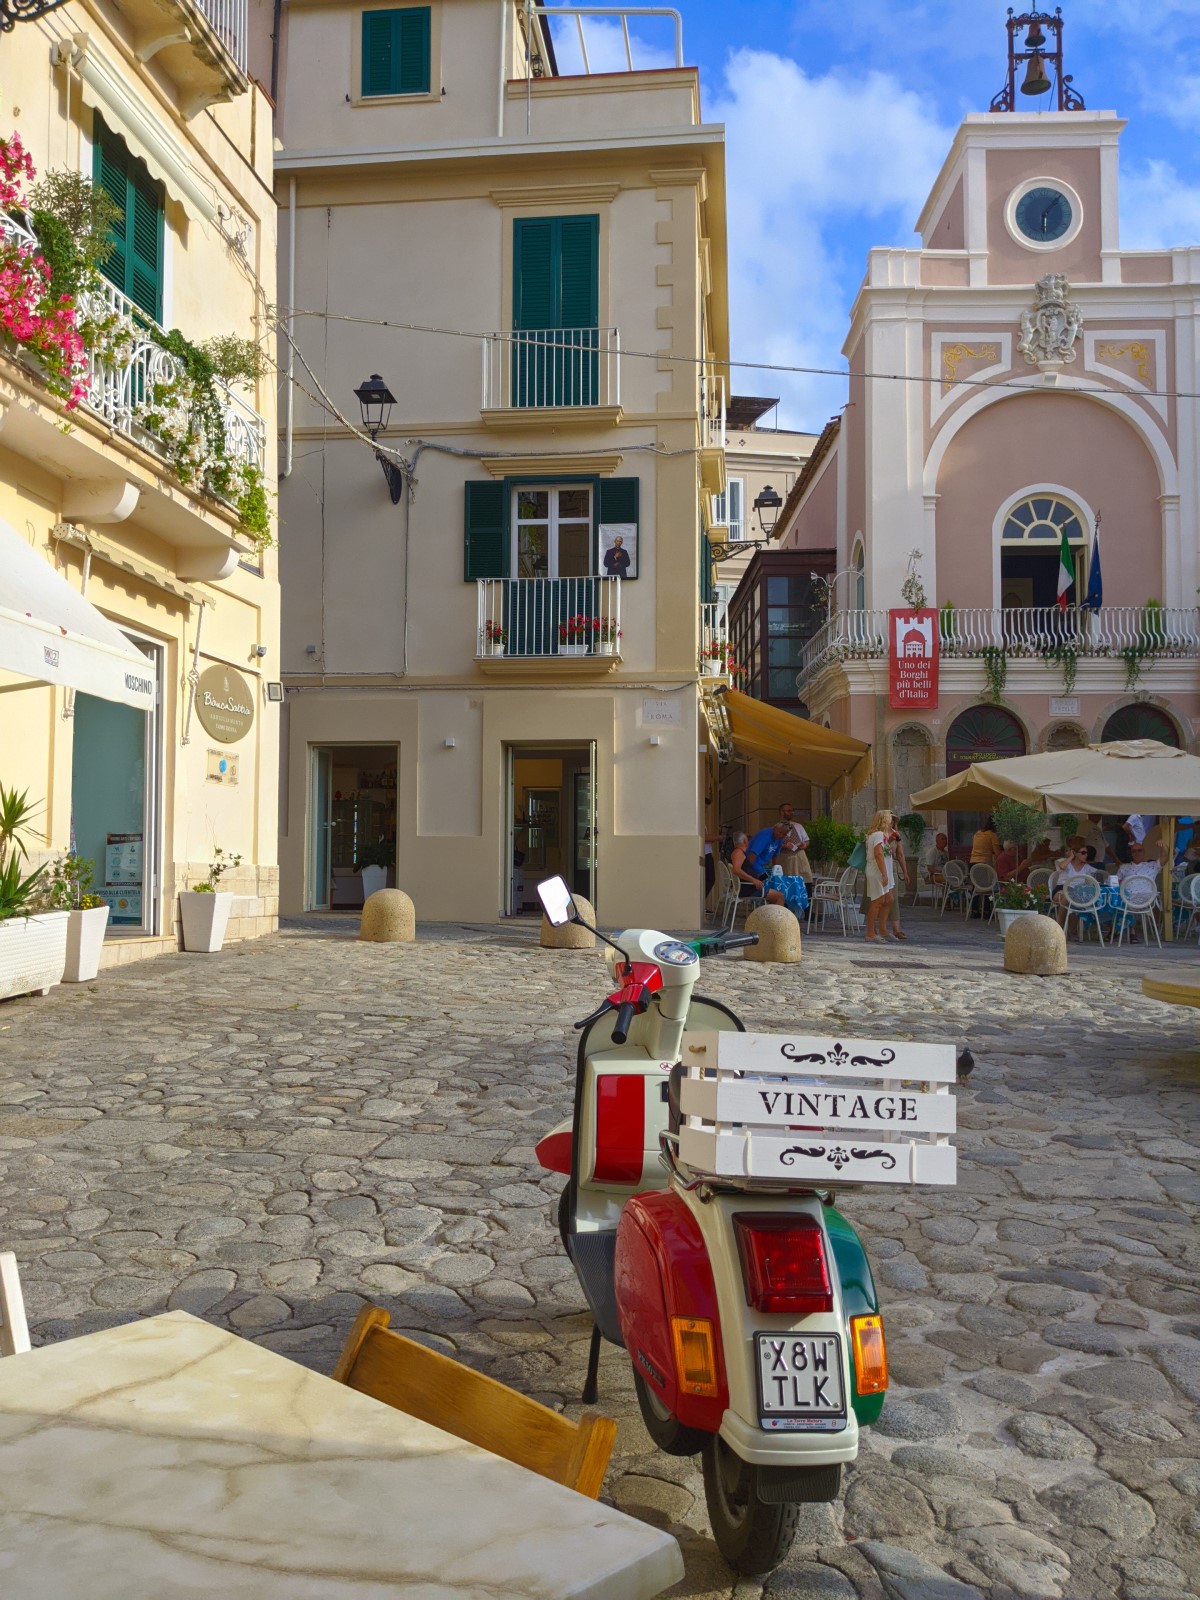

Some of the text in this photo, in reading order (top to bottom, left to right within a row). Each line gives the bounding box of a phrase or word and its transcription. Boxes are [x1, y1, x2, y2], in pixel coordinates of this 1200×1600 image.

[898, 660, 931, 669] Uno dei
[900, 670, 929, 680] Borghi
[125, 673, 152, 695] MOSCHINO
[896, 680, 932, 690] più belli
[899, 689, 929, 698] d'Italia
[758, 1091, 918, 1121] VINTAGE
[770, 1341, 828, 1371] X8W
[772, 1375, 831, 1407] TLK
